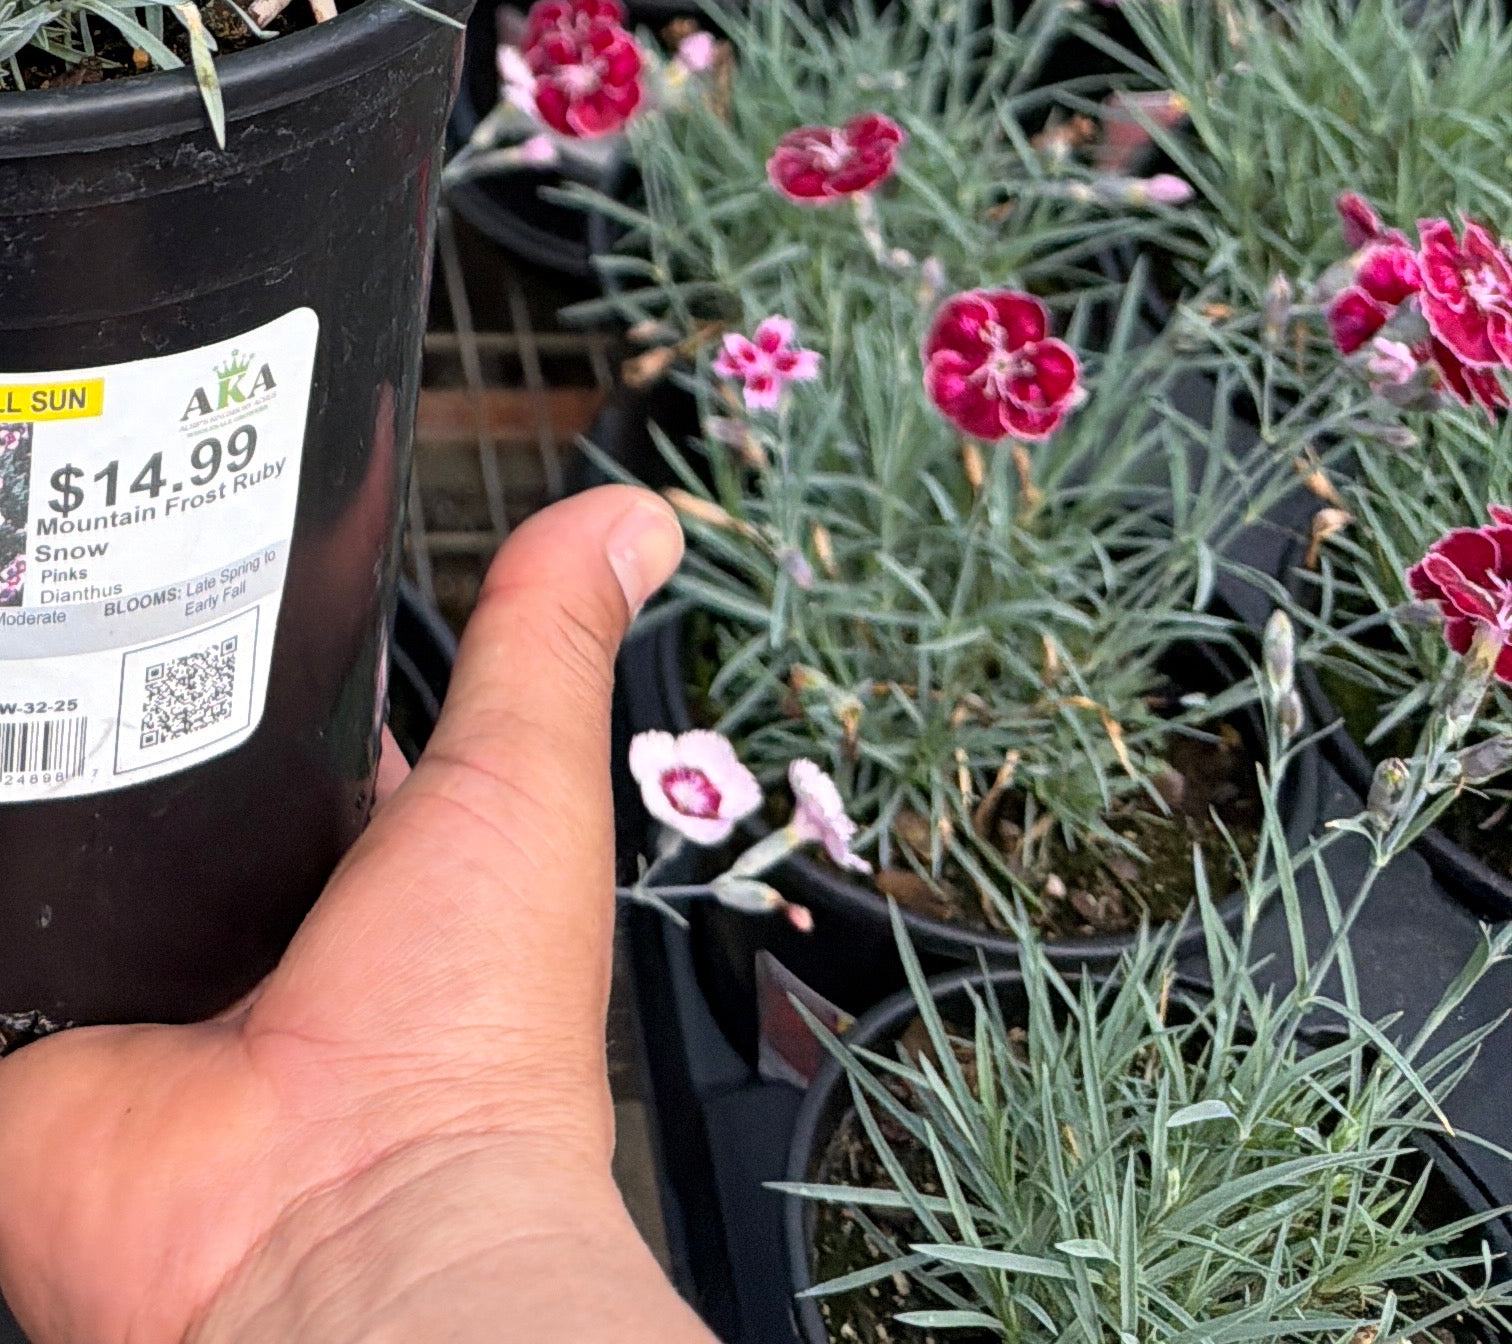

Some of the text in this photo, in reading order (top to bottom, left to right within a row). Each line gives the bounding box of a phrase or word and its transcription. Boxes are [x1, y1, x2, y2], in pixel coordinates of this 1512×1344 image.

[31, 387, 87, 412] SUN
[179, 361, 277, 421] AKA
[48, 424, 258, 518] $14.99
[36, 457, 287, 536] Mountain Frost Ruby
[35, 542, 109, 563] Snow
[41, 567, 88, 584] Pinks
[41, 583, 123, 604] Dianthus
[104, 549, 276, 617] BLOOMS: Late Spring to
[185, 580, 246, 617] Early Fall
